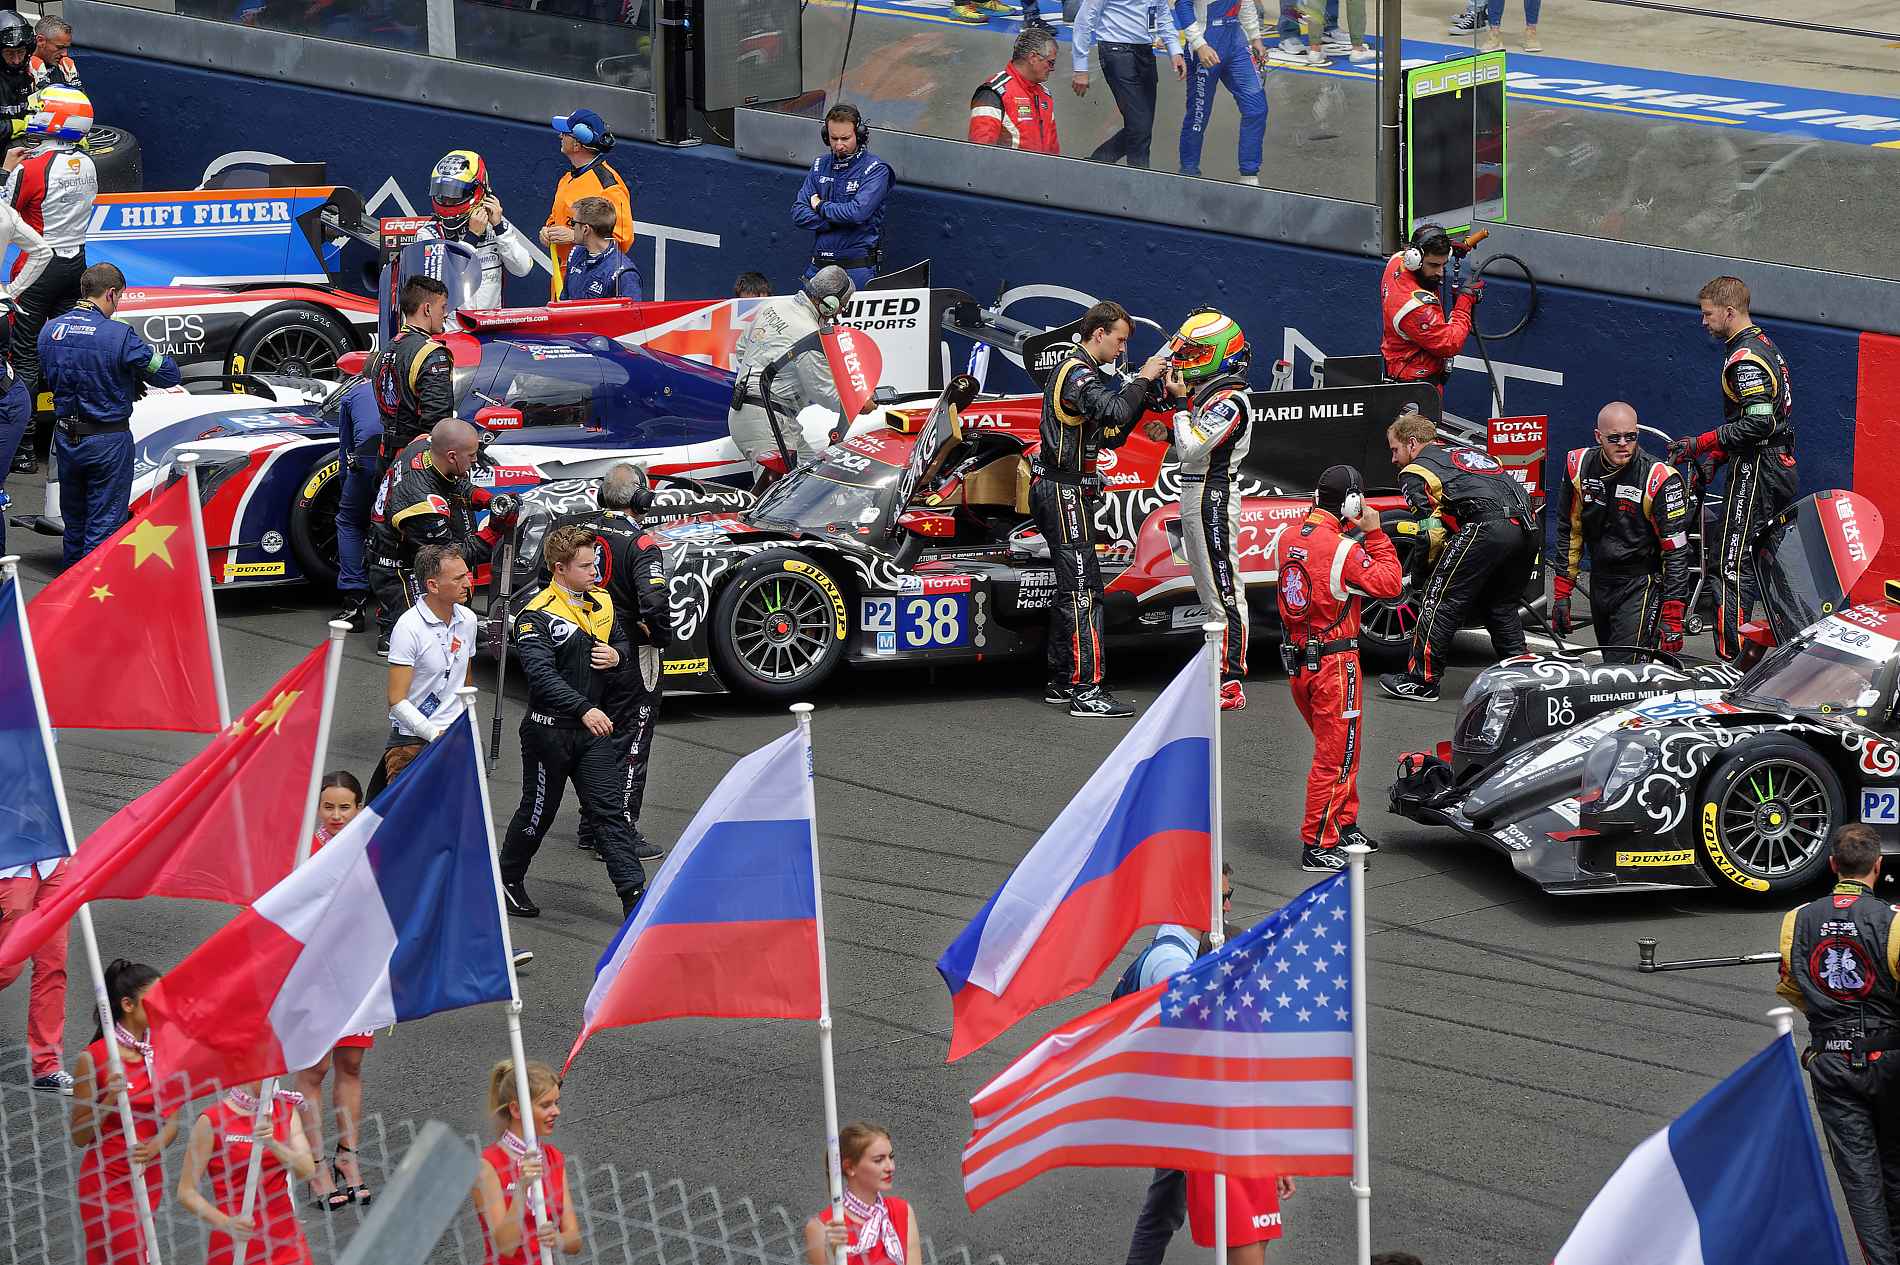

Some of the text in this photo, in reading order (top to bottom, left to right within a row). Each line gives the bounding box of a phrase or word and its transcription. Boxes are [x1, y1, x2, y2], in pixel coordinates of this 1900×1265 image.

[1415, 65, 1500, 97] eurasia
[120, 201, 291, 228] HIFI FILTER
[144, 315, 205, 342] CPS
[766, 305, 791, 335] OFFICIAL
[488, 417, 518, 426] MOTUL
[1252, 403, 1364, 422] HARD MILLE
[1492, 432, 1543, 443] 道达尔
[1493, 421, 1543, 431] TOTAL
[661, 513, 690, 523] MILLE
[235, 565, 281, 573] DUNLOP
[925, 578, 969, 588] TOTAL
[1018, 587, 1058, 598] Futur
[803, 564, 847, 632] DUNLOP
[864, 602, 892, 626] P2
[905, 597, 960, 646] 38
[1590, 691, 1635, 703] RICHARD
[531, 761, 547, 826] DUNLOP
[1864, 792, 1896, 819] P2
[1505, 823, 1533, 848] TOTAL
[1630, 853, 1692, 863] DUNLOP
[1703, 812, 1750, 886] DUNLOP
